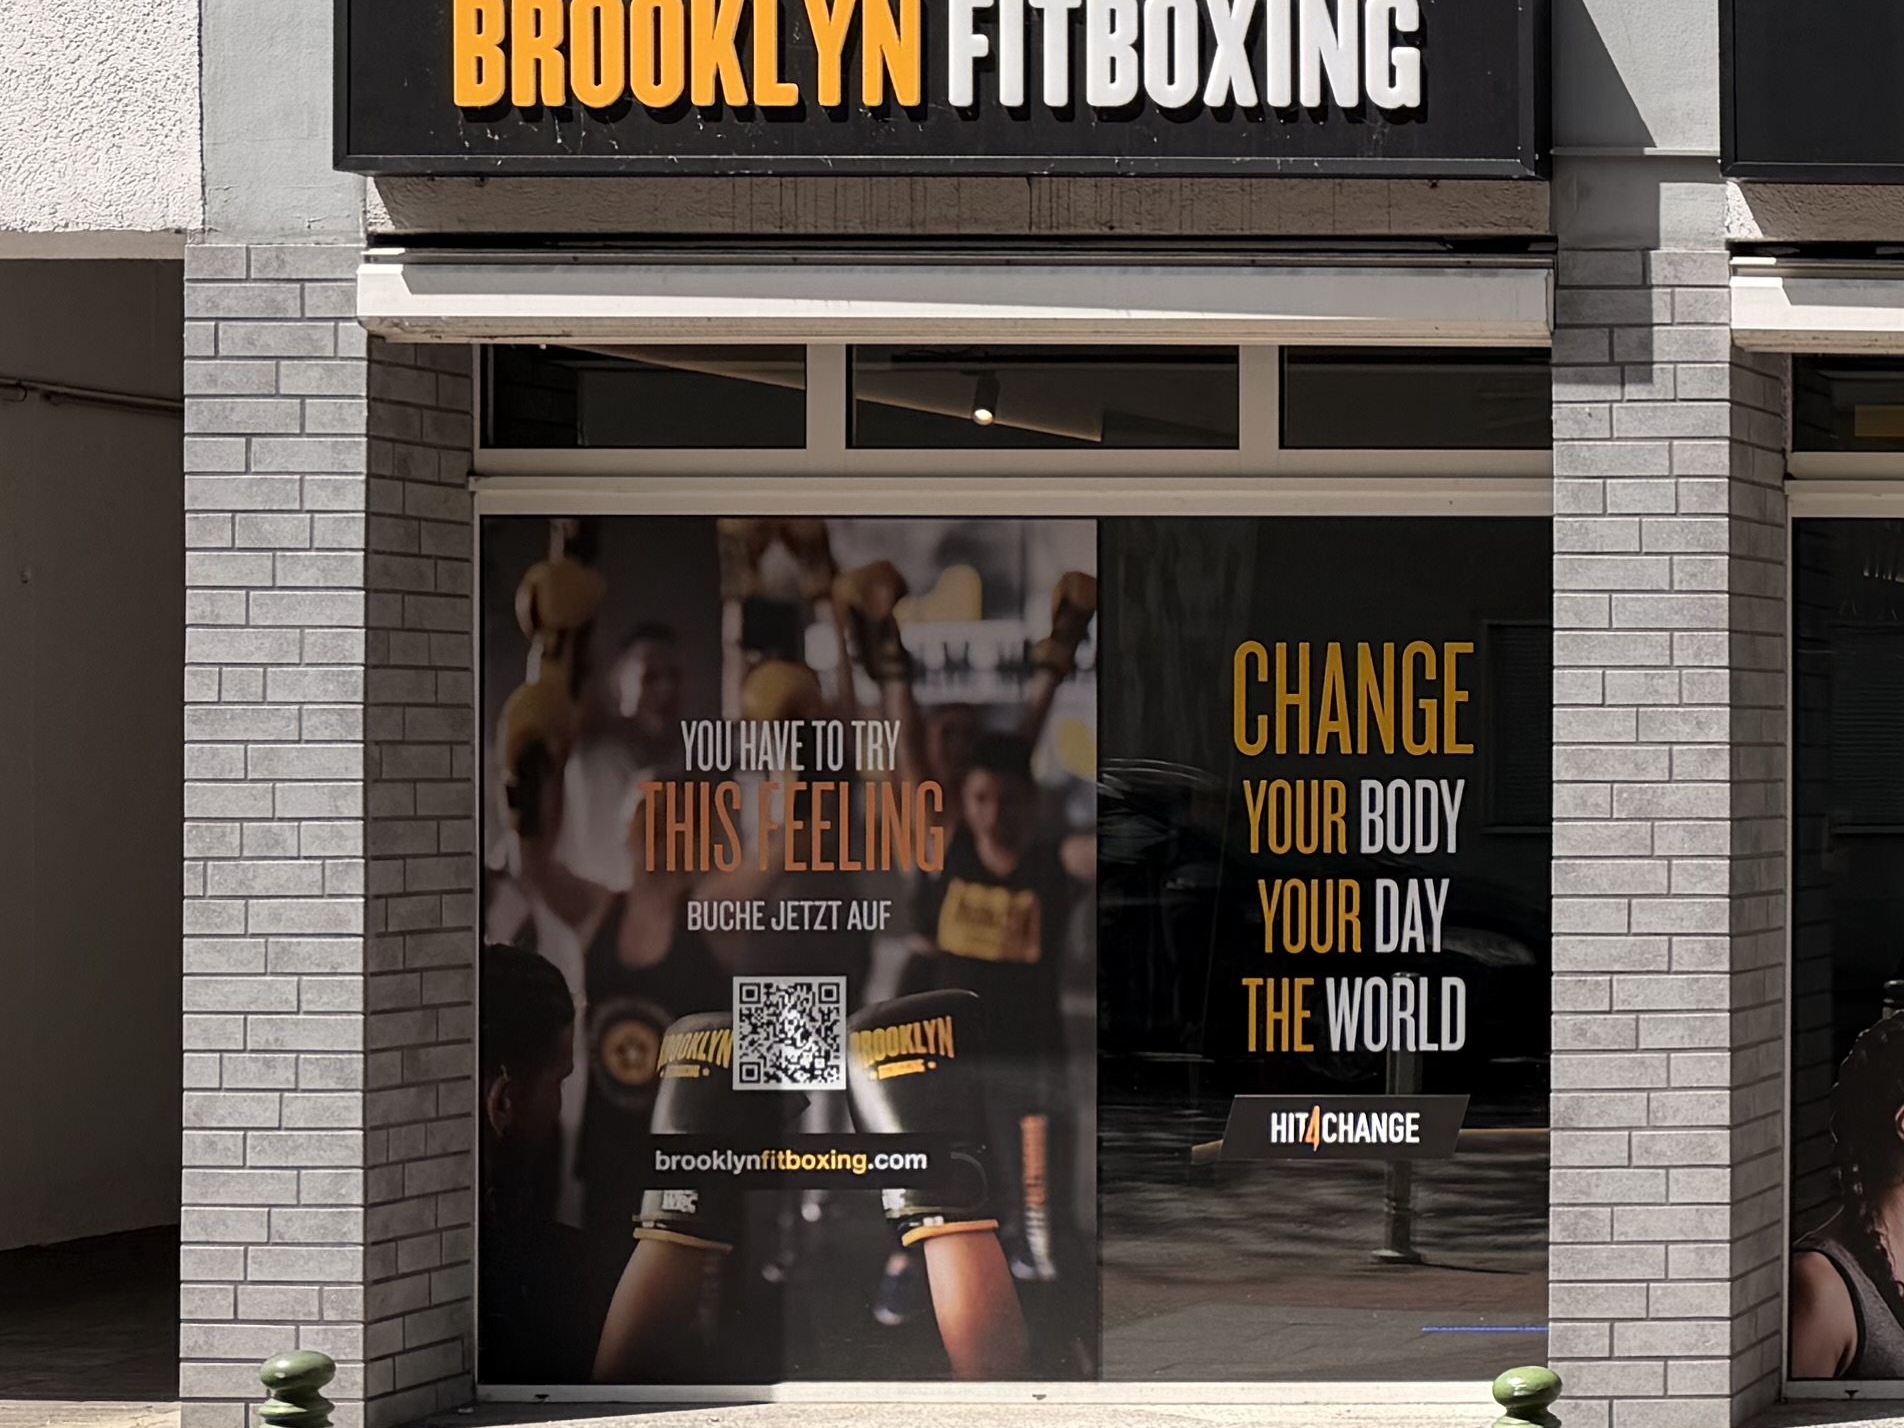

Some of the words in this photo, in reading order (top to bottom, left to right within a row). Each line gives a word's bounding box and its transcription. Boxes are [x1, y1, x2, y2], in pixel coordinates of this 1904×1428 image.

[1233, 639, 1475, 756] CHANGE
[681, 719, 733, 772] YOU
[740, 719, 806, 772] HAVE
[812, 719, 844, 772] TO
[851, 719, 901, 772] TRY
[637, 781, 741, 872] THIS
[757, 781, 945, 872] FEELING
[1243, 778, 1348, 855] YOUR
[1360, 778, 1466, 855] BODY
[688, 899, 765, 932] BUCHE
[771, 899, 841, 932] JETZT
[845, 899, 893, 932] AUF
[1257, 877, 1362, 954] YOUR
[1375, 877, 1450, 954] DAY
[1241, 976, 1315, 1052] THE
[1325, 976, 1467, 1052] WORLD
[657, 1028, 734, 1072] OOKLYN
[1270, 1104, 1421, 1152] HIT4CHANGE
[655, 1149, 928, 1176] brooklynfitboxing.com
